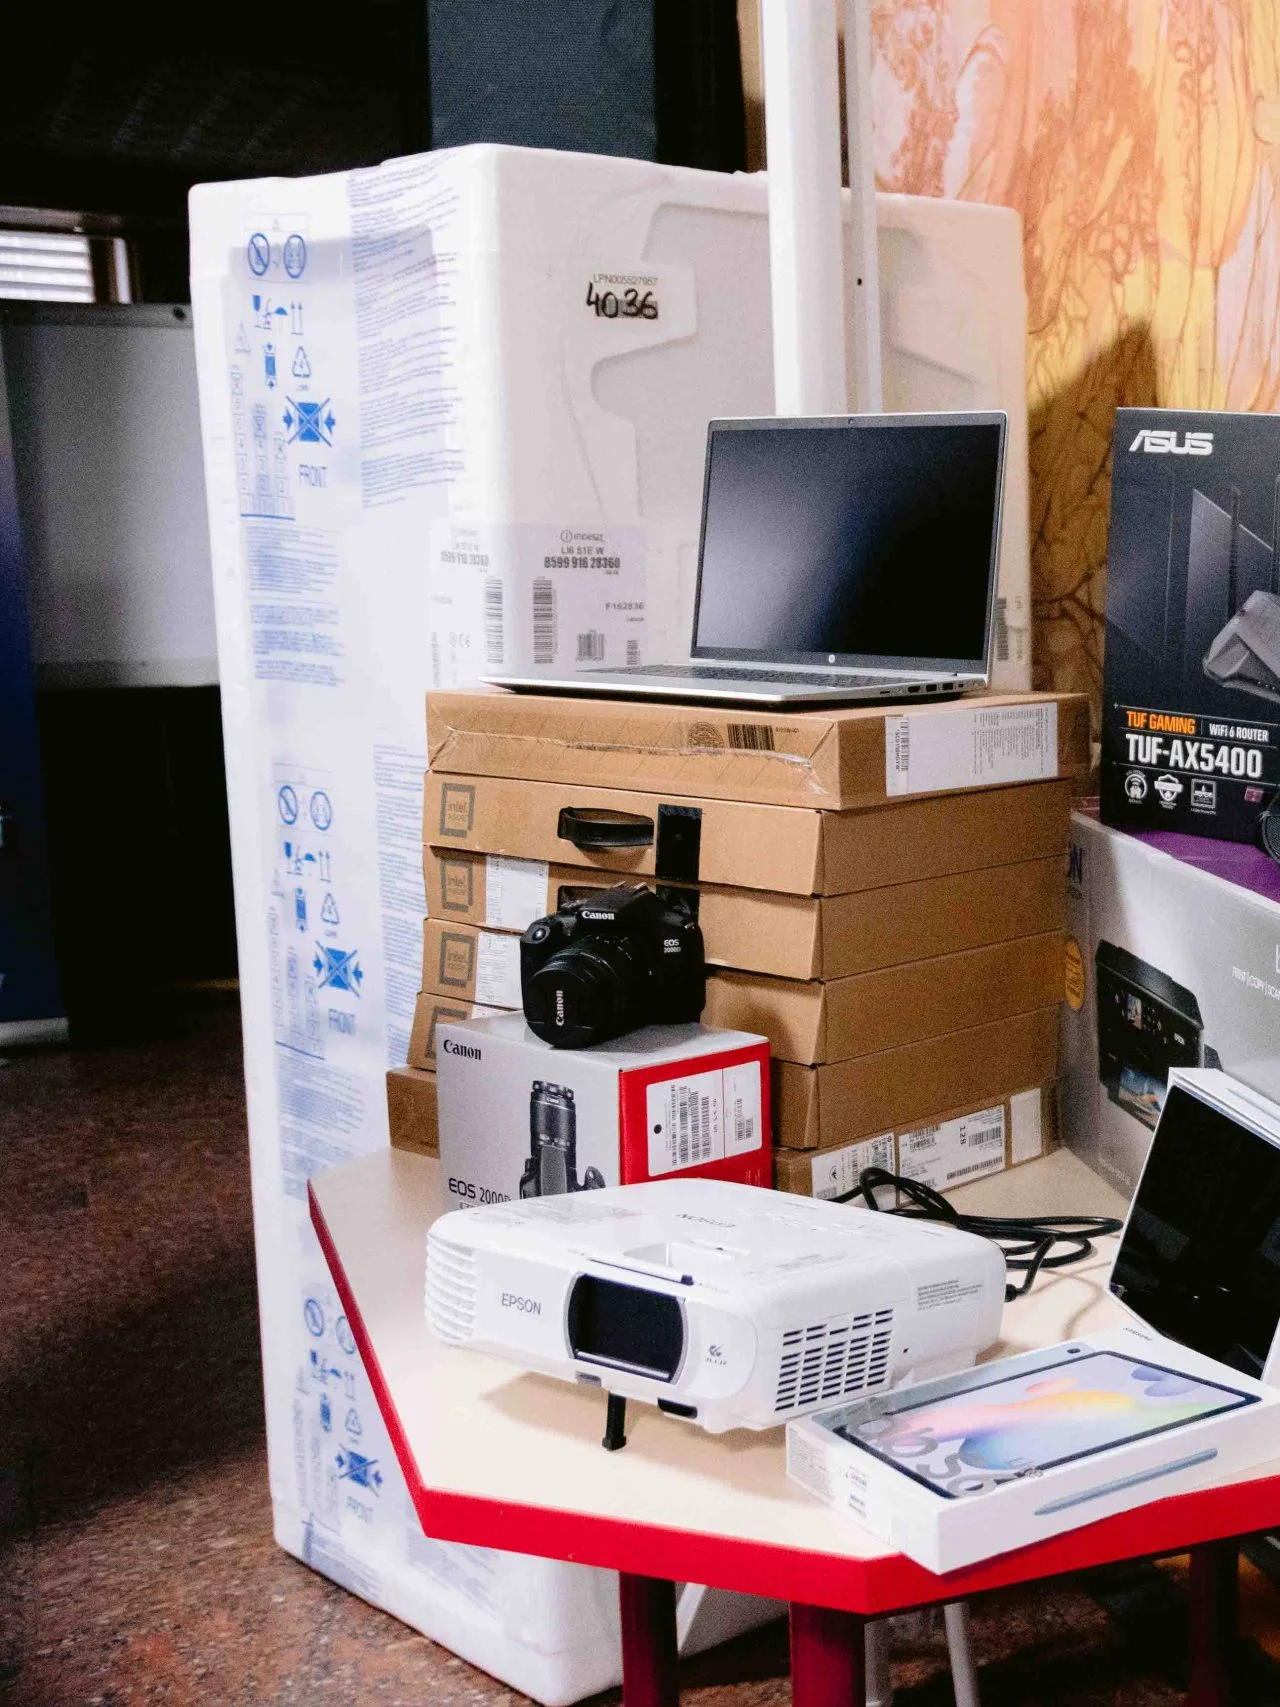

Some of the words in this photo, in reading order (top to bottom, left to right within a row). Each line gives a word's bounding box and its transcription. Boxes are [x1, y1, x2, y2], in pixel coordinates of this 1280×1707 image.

[586, 282, 658, 319] 4036
[1128, 430, 1213, 456] ASUS
[544, 556, 570, 569] 8599
[1125, 710, 1147, 728] TUF
[1149, 713, 1196, 734] GAMING
[1229, 726, 1235, 738] 6
[1236, 727, 1270, 742] ROUTER
[1125, 733, 1263, 778] TUF-AX5400
[581, 910, 615, 921] Canon
[663, 939, 680, 947] EOS
[555, 990, 565, 1026] Canon
[443, 1039, 482, 1060] Canon
[448, 1177, 476, 1199] EOS
[502, 1292, 541, 1315] EPSON
